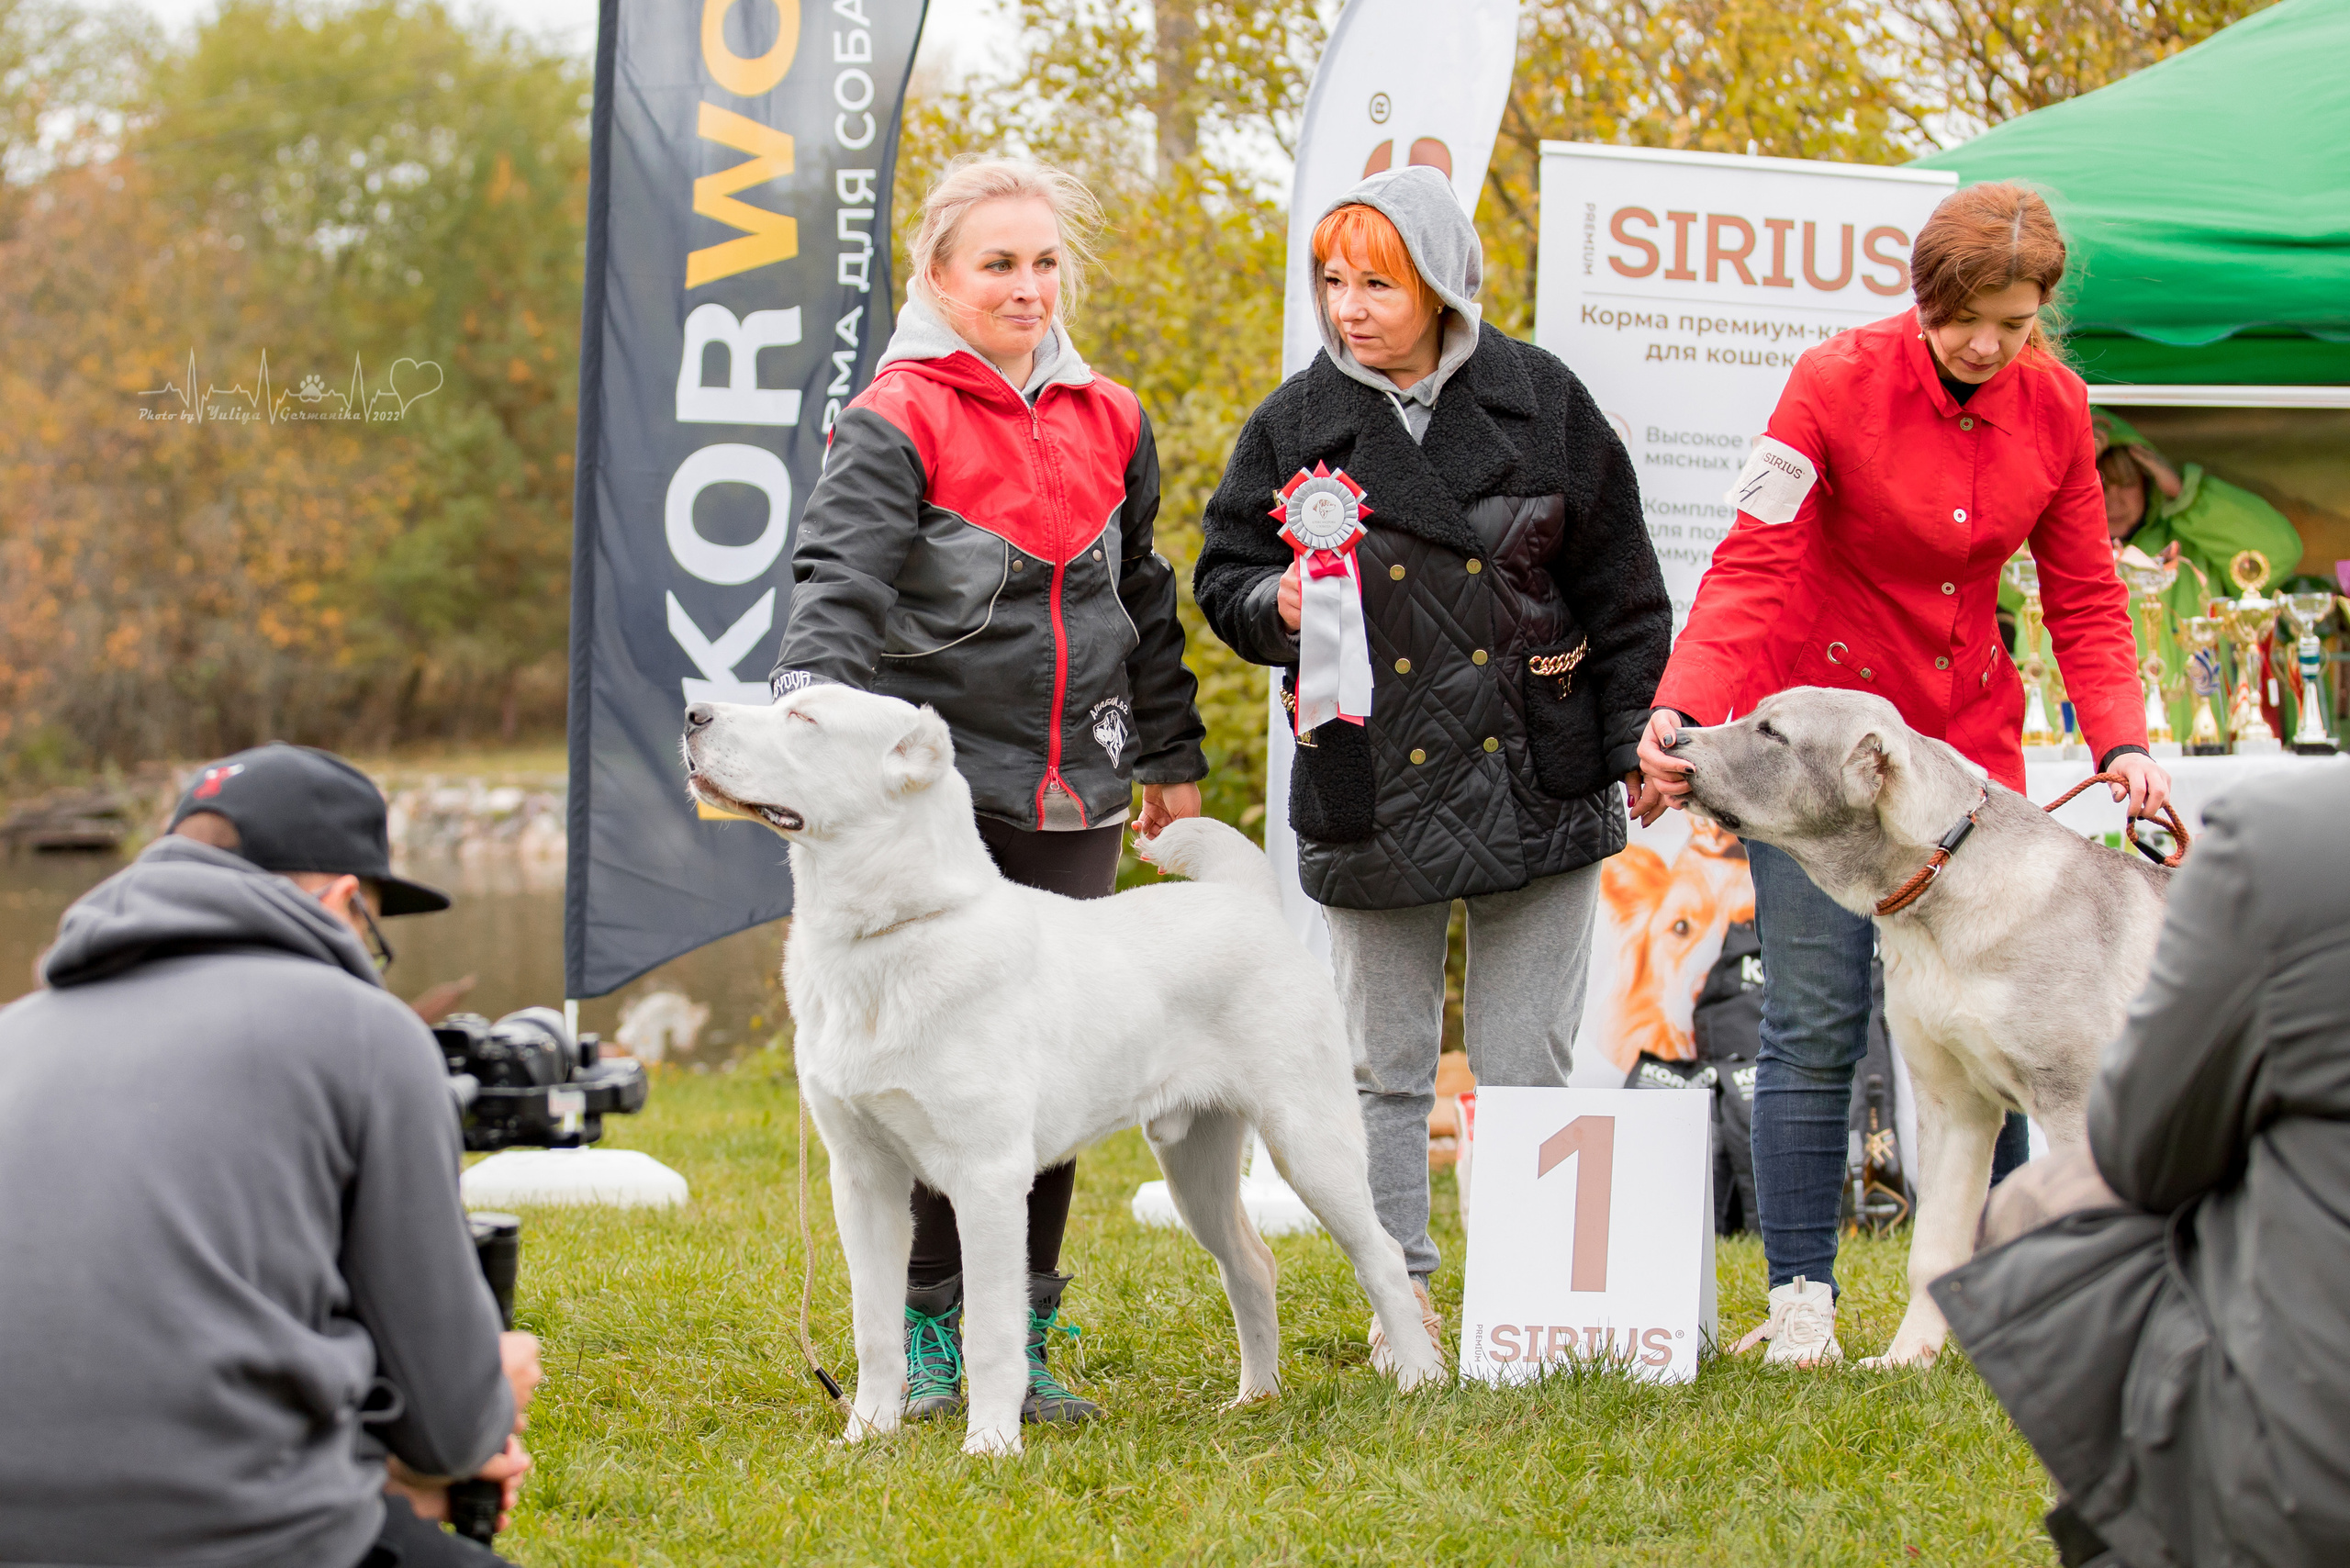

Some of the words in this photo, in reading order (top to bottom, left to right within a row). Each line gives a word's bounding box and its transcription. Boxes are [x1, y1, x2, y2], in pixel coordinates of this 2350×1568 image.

[836, 169, 878, 293] ДЛЯ
[1607, 206, 1910, 296] SIRIUS
[1581, 304, 1669, 331] Корма
[1645, 343, 1696, 362] для
[1707, 347, 1796, 367] кошек
[821, 305, 864, 471] РМА
[1646, 426, 1742, 447] Высокое
[1645, 452, 1729, 470] мясных
[1762, 453, 1803, 479] SIRIUS
[1538, 1114, 1616, 1293] 1
[1474, 1324, 1483, 1362] PREMIUM
